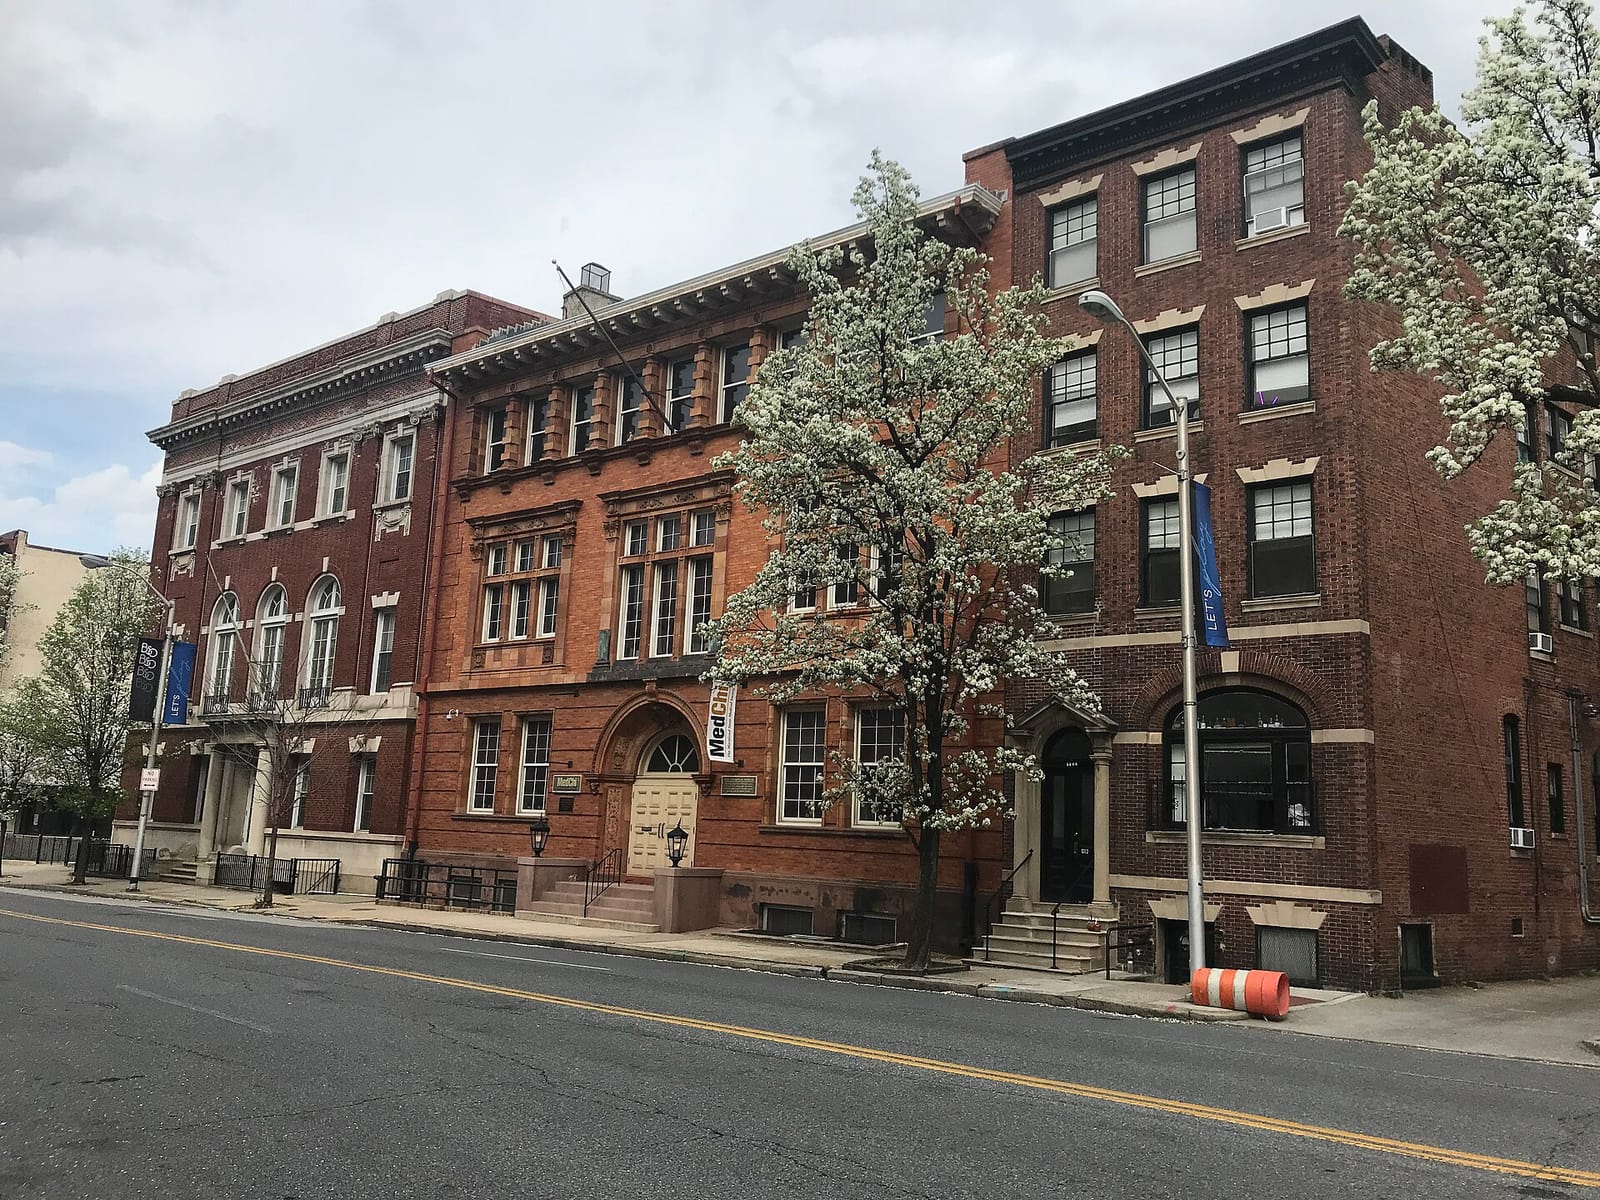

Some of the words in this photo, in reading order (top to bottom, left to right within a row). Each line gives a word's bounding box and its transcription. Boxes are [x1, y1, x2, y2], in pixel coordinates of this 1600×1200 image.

[1203, 589, 1218, 631] LET'S
[140, 642, 158, 658] BSO
[138, 653, 157, 669] BSO
[136, 665, 155, 681] BSO
[171, 694, 180, 717] LET'S
[709, 685, 729, 758] MedChi
